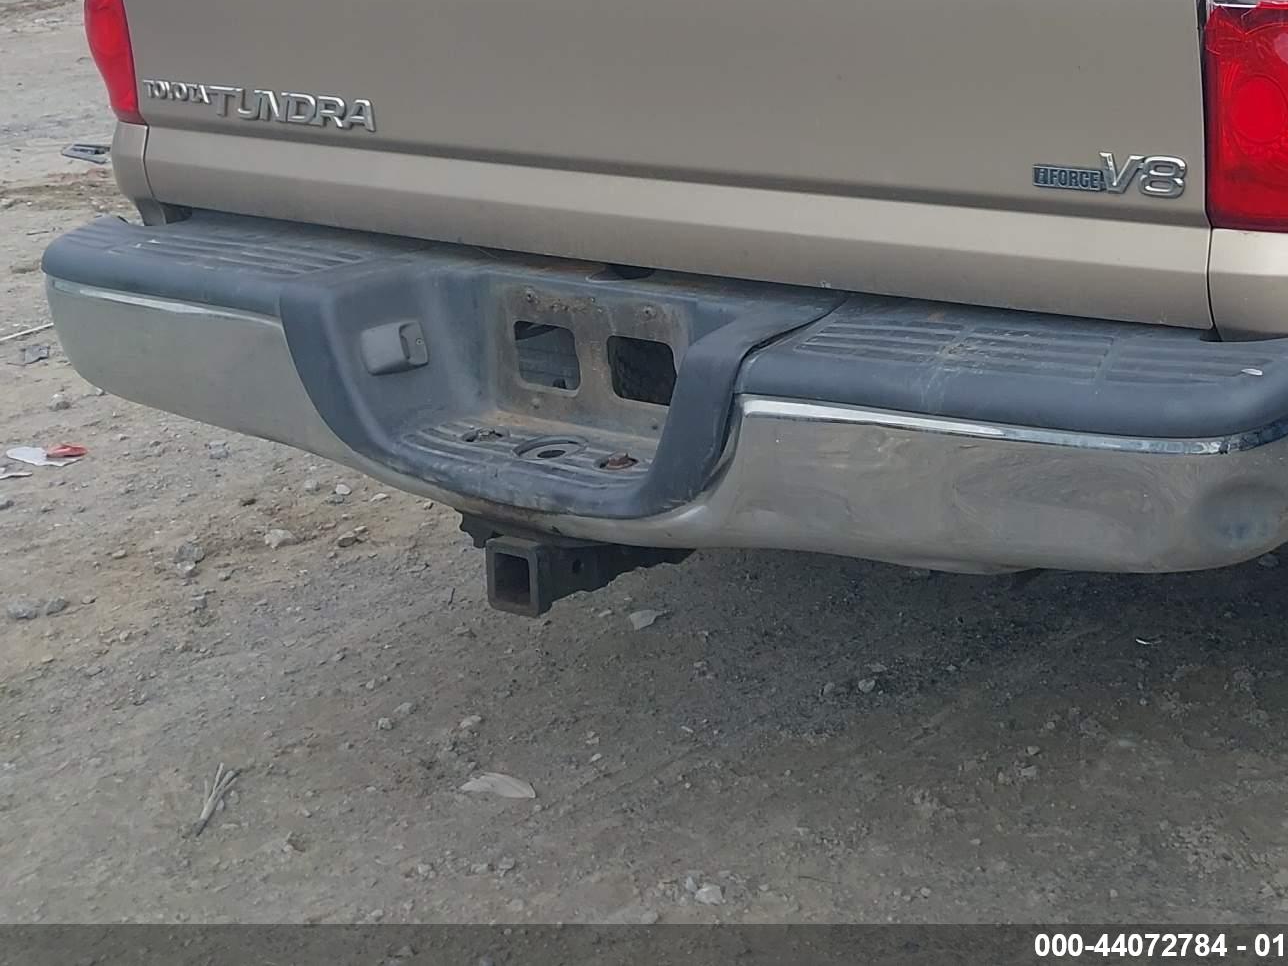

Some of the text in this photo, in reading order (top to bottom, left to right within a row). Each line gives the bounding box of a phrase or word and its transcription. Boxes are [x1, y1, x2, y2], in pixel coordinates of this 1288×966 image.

[142, 79, 376, 133] TOYOTA TUNDRA
[1099, 151, 1188, 199] V8
